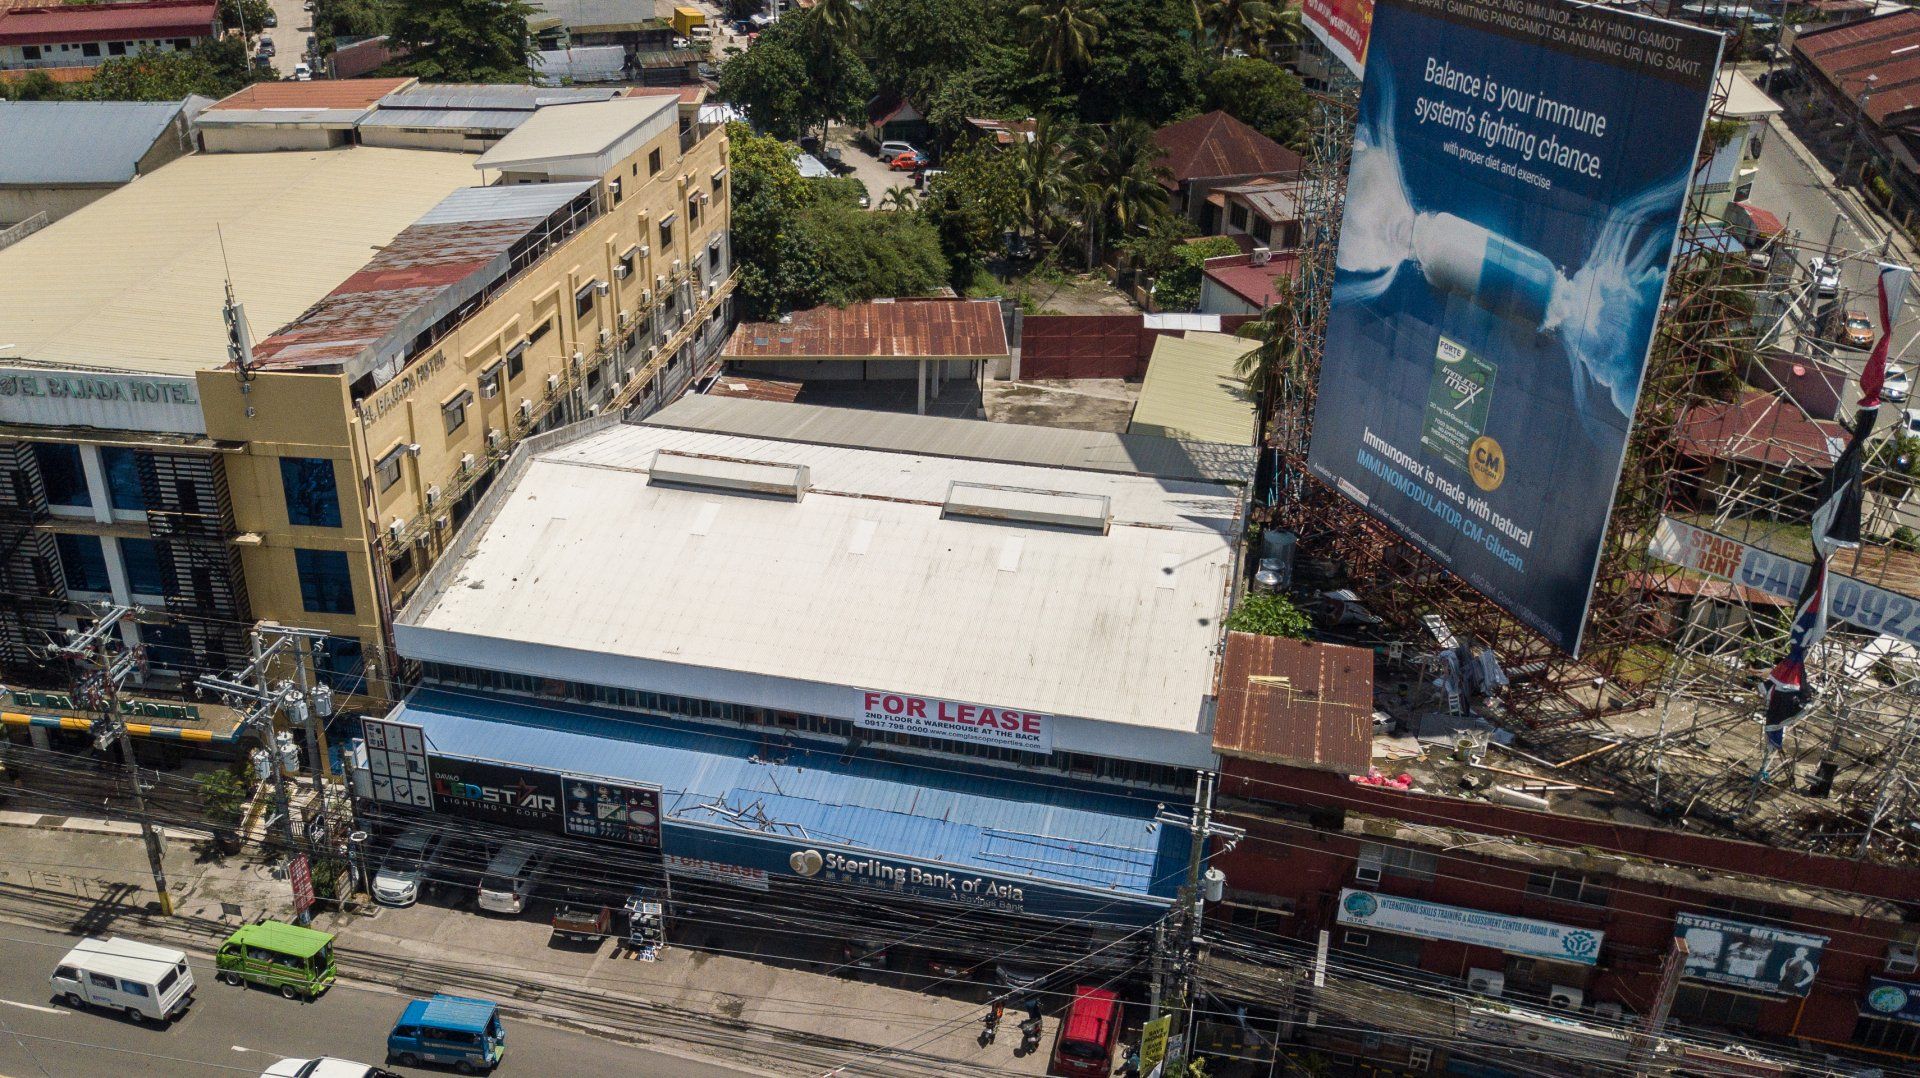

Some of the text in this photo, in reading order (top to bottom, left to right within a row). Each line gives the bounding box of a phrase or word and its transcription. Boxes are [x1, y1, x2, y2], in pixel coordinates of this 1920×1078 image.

[1447, 1, 1488, 22] GAMITING
[1490, 11, 1552, 37] PANGGAMOT
[1552, 28, 1567, 43] SA
[1568, 33, 1622, 56] ANUMANG
[1623, 44, 1643, 62] URI
[1644, 49, 1663, 67] NG
[1665, 55, 1701, 78] SAKIT.
[1525, 3, 1589, 30] IMMUNOX
[1589, 18, 1606, 33] AY
[1606, 22, 1636, 42] HINDI
[1638, 30, 1683, 53] GAMOT
[1424, 57, 1606, 137] Balance is your immune
[1414, 96, 1602, 179] system's fighting chance.
[1443, 141, 1551, 190] with proper diet and exercise
[1439, 340, 1462, 357] FORTE
[20, 377, 197, 404] EL BAJADA HOTEL
[1476, 447, 1500, 472] CM
[1363, 426, 1425, 479] Immunomax
[1425, 465, 1436, 485] is
[1435, 474, 1466, 505] made
[1466, 494, 1491, 521] with
[1491, 511, 1534, 549] natural
[1357, 449, 1526, 574] IMMUNOMODULATOR CM-Glucan.
[1691, 529, 1745, 563] SPACE
[864, 692, 1042, 734] FOR LEASE
[865, 719, 885, 728] 0917
[865, 711, 883, 720] 2ND
[884, 714, 913, 724] FLOOR
[924, 719, 979, 734] WAREHOUSE
[981, 727, 994, 735] AT
[995, 729, 1013, 738] THE
[1015, 733, 1040, 742] BACK
[825, 853, 1024, 902] Sterling Bank of Asia
[1380, 899, 1419, 914] INTERNATIONAL
[1438, 908, 1462, 922] TRAINING
[1467, 914, 1502, 928] ASSESSMENT
[1502, 919, 1522, 932] CENTER
[1522, 922, 1529, 933] OF
[1676, 916, 1722, 932] ISTAC
